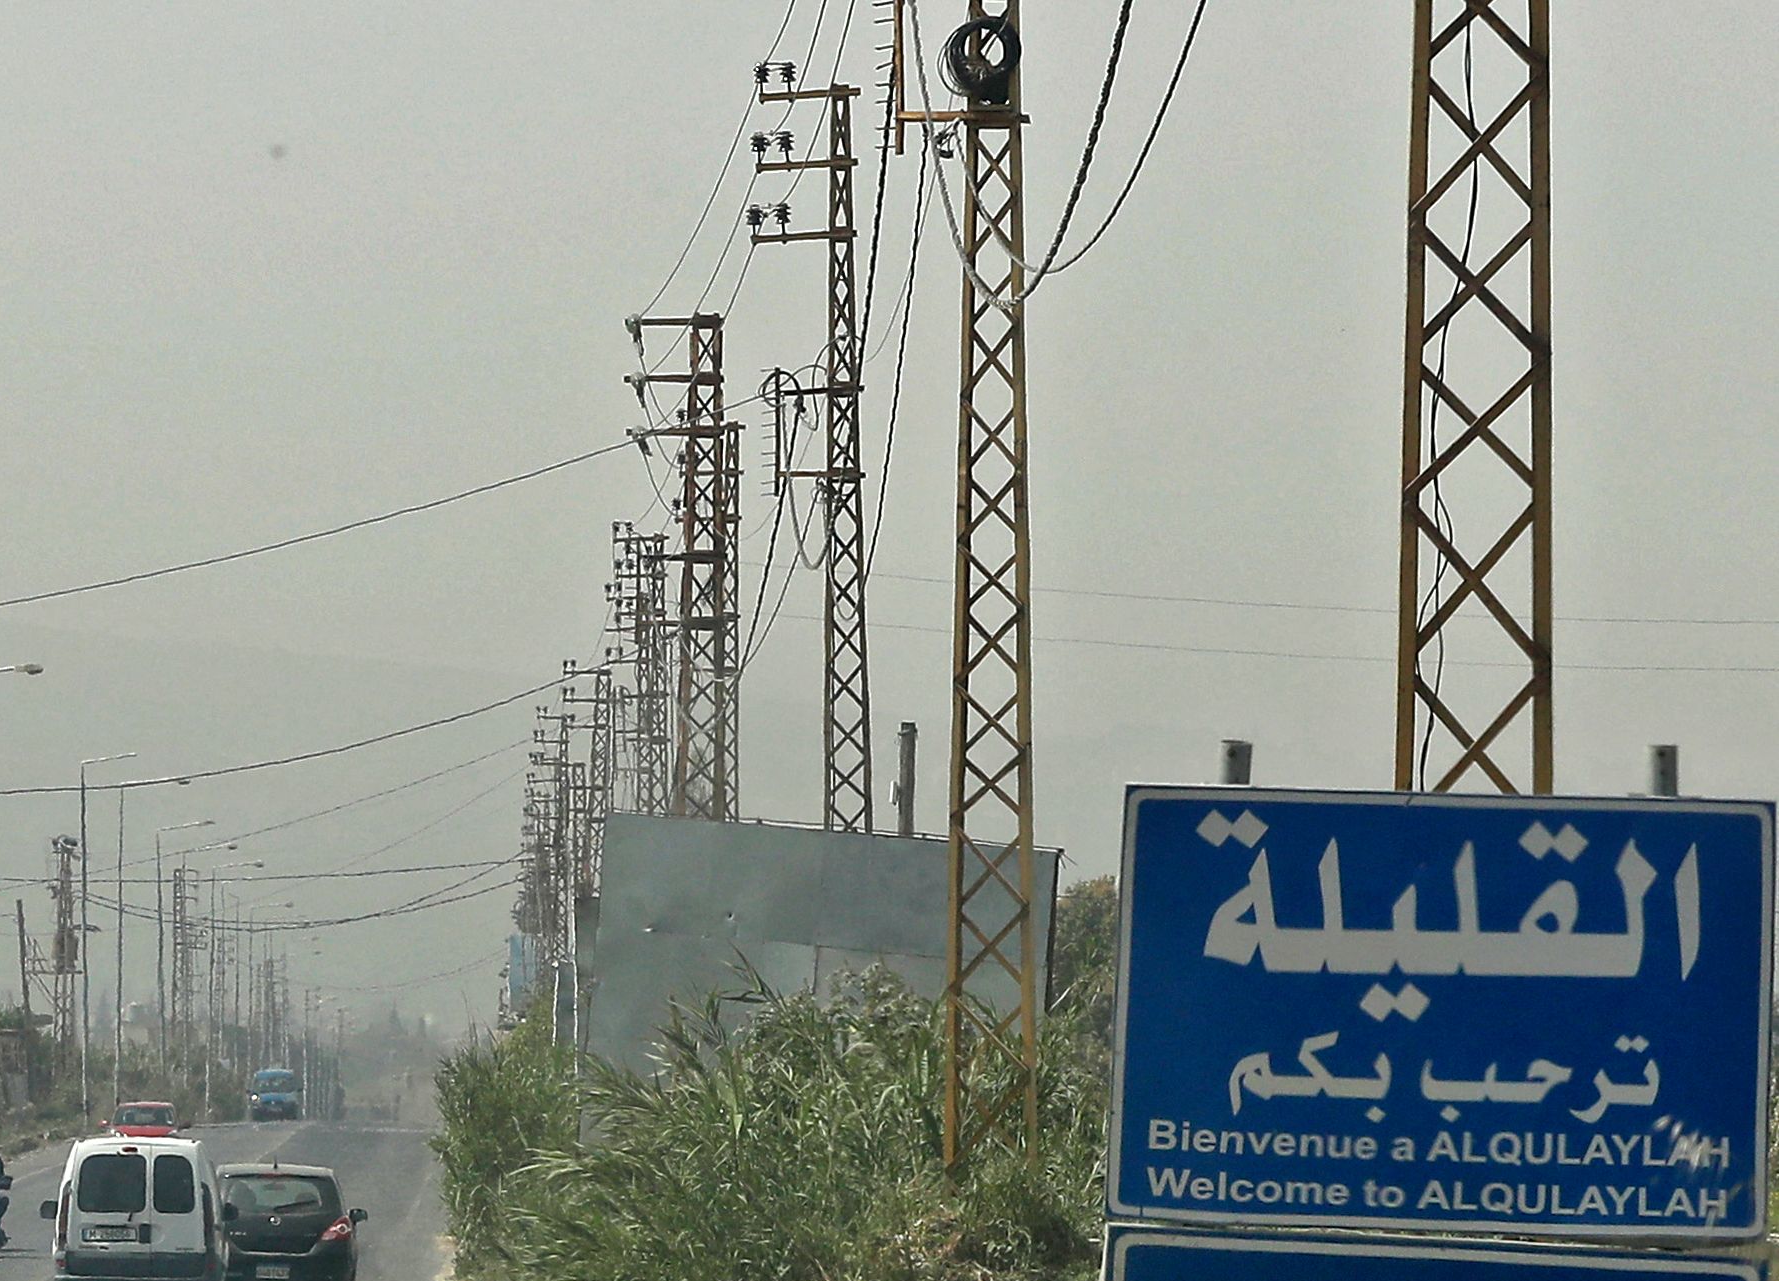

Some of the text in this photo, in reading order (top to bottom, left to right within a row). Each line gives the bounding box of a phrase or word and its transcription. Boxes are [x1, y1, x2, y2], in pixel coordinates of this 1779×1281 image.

[1196, 809, 1701, 1022] القليلة
[1229, 1031, 1660, 1124] ترحب بكم
[1148, 1119, 1379, 1161] Bienvenue
[1426, 1131, 1729, 1168] ALQULAYLAH
[1147, 1167, 1728, 1219] Welcome to ALQULAYLAH
